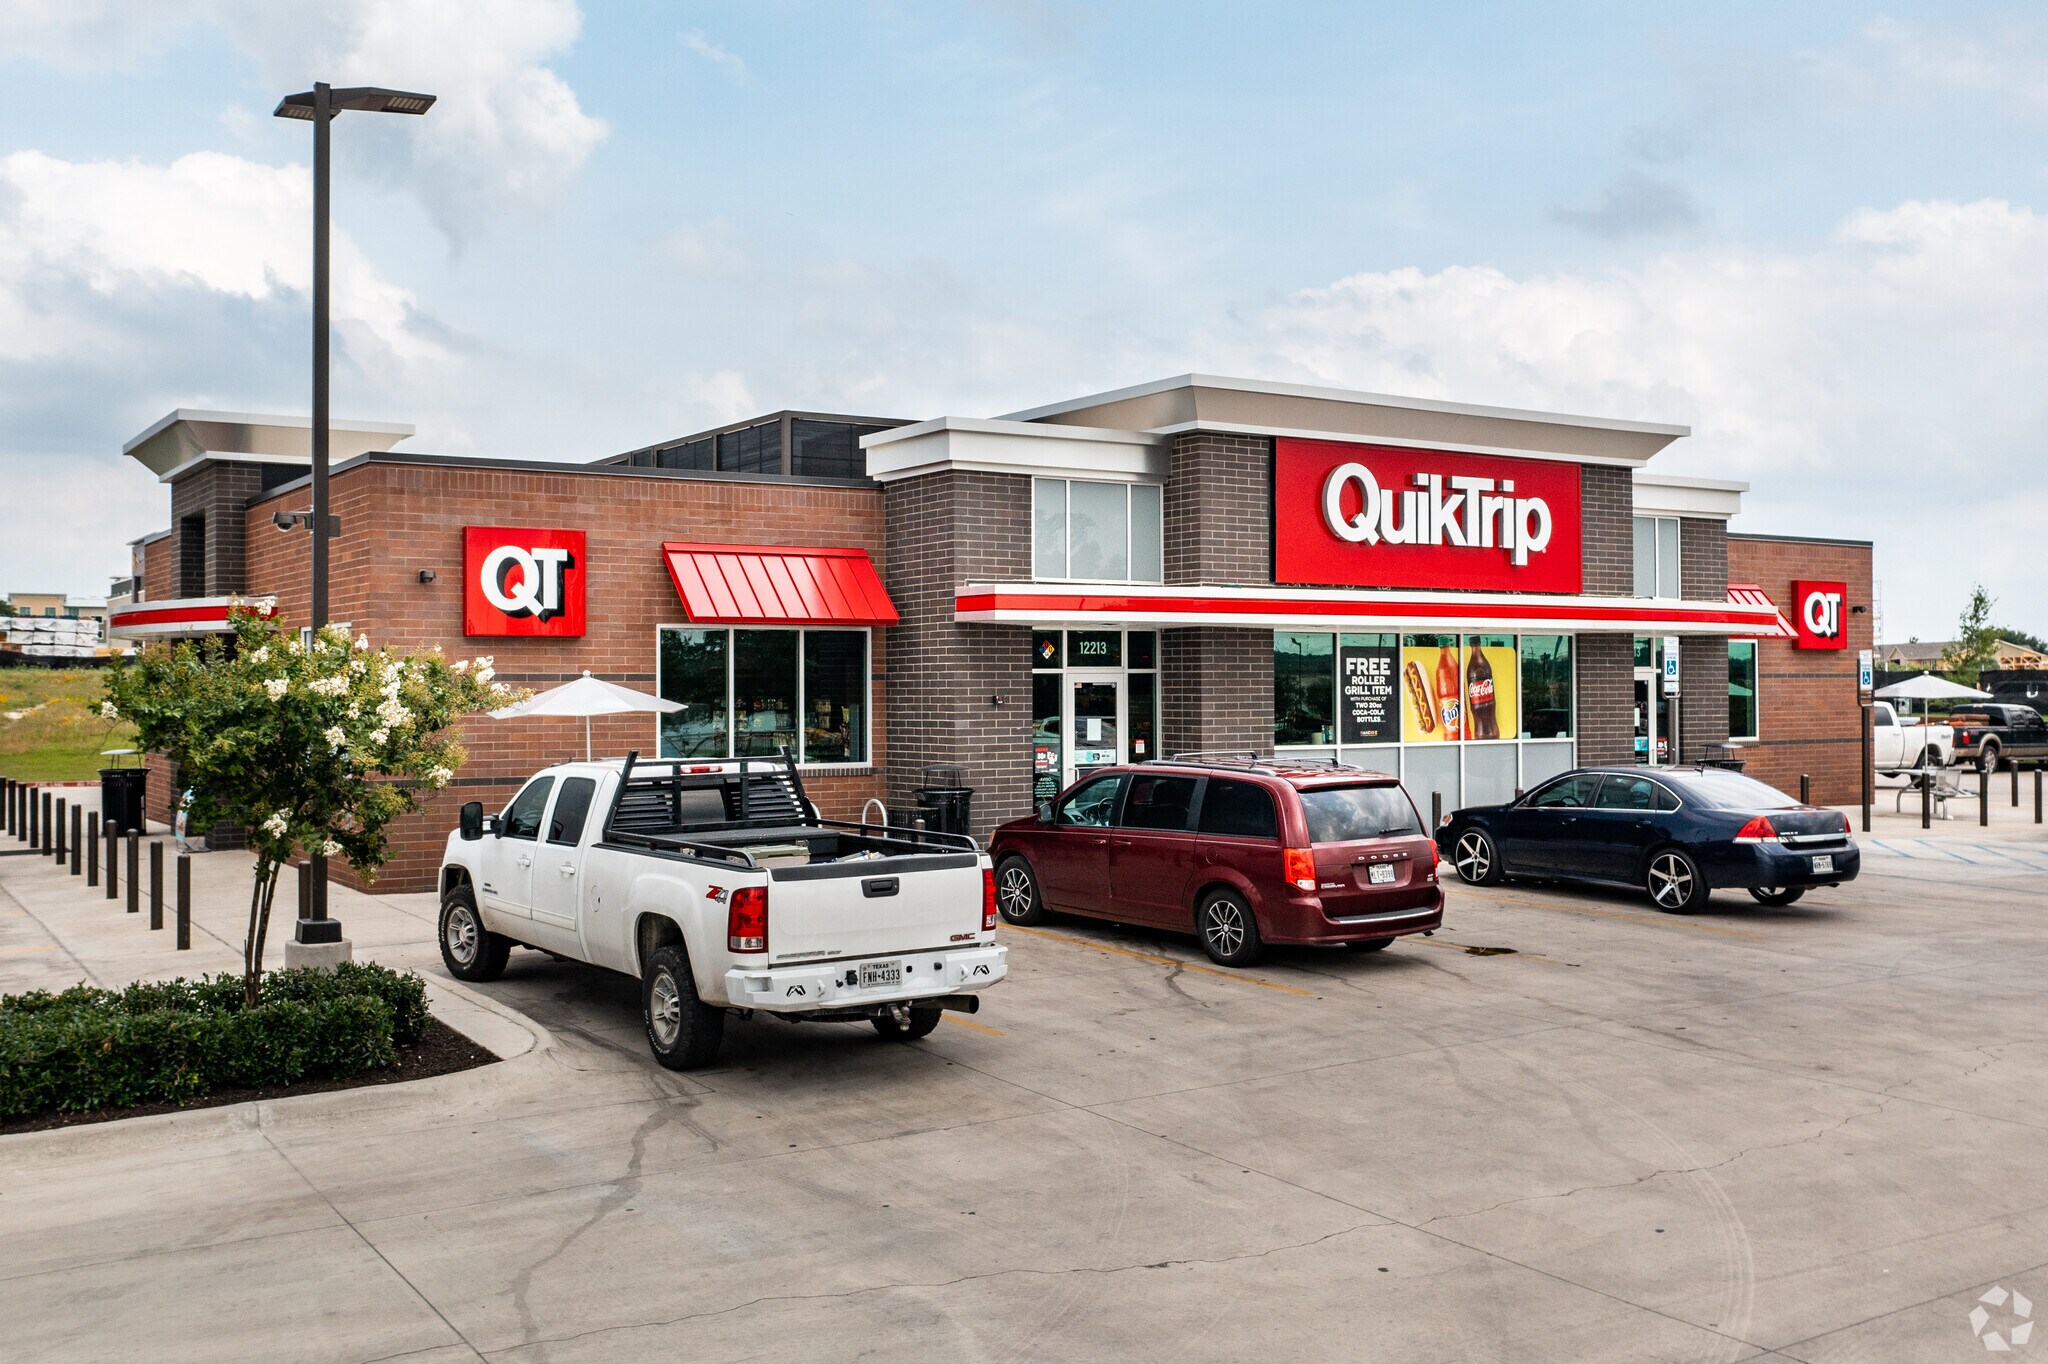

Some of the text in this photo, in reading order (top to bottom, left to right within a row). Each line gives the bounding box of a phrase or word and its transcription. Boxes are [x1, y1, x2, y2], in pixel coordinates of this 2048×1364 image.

[1322, 462, 1552, 566] QuikTrip
[481, 545, 571, 619] QT
[1804, 591, 1841, 637] QT
[1079, 641, 1107, 654] 12213
[1346, 657, 1391, 675] FREE
[1351, 676, 1386, 685] ROLLER
[1344, 686, 1392, 695] GRILL ITEM
[950, 933, 975, 942] GMC
